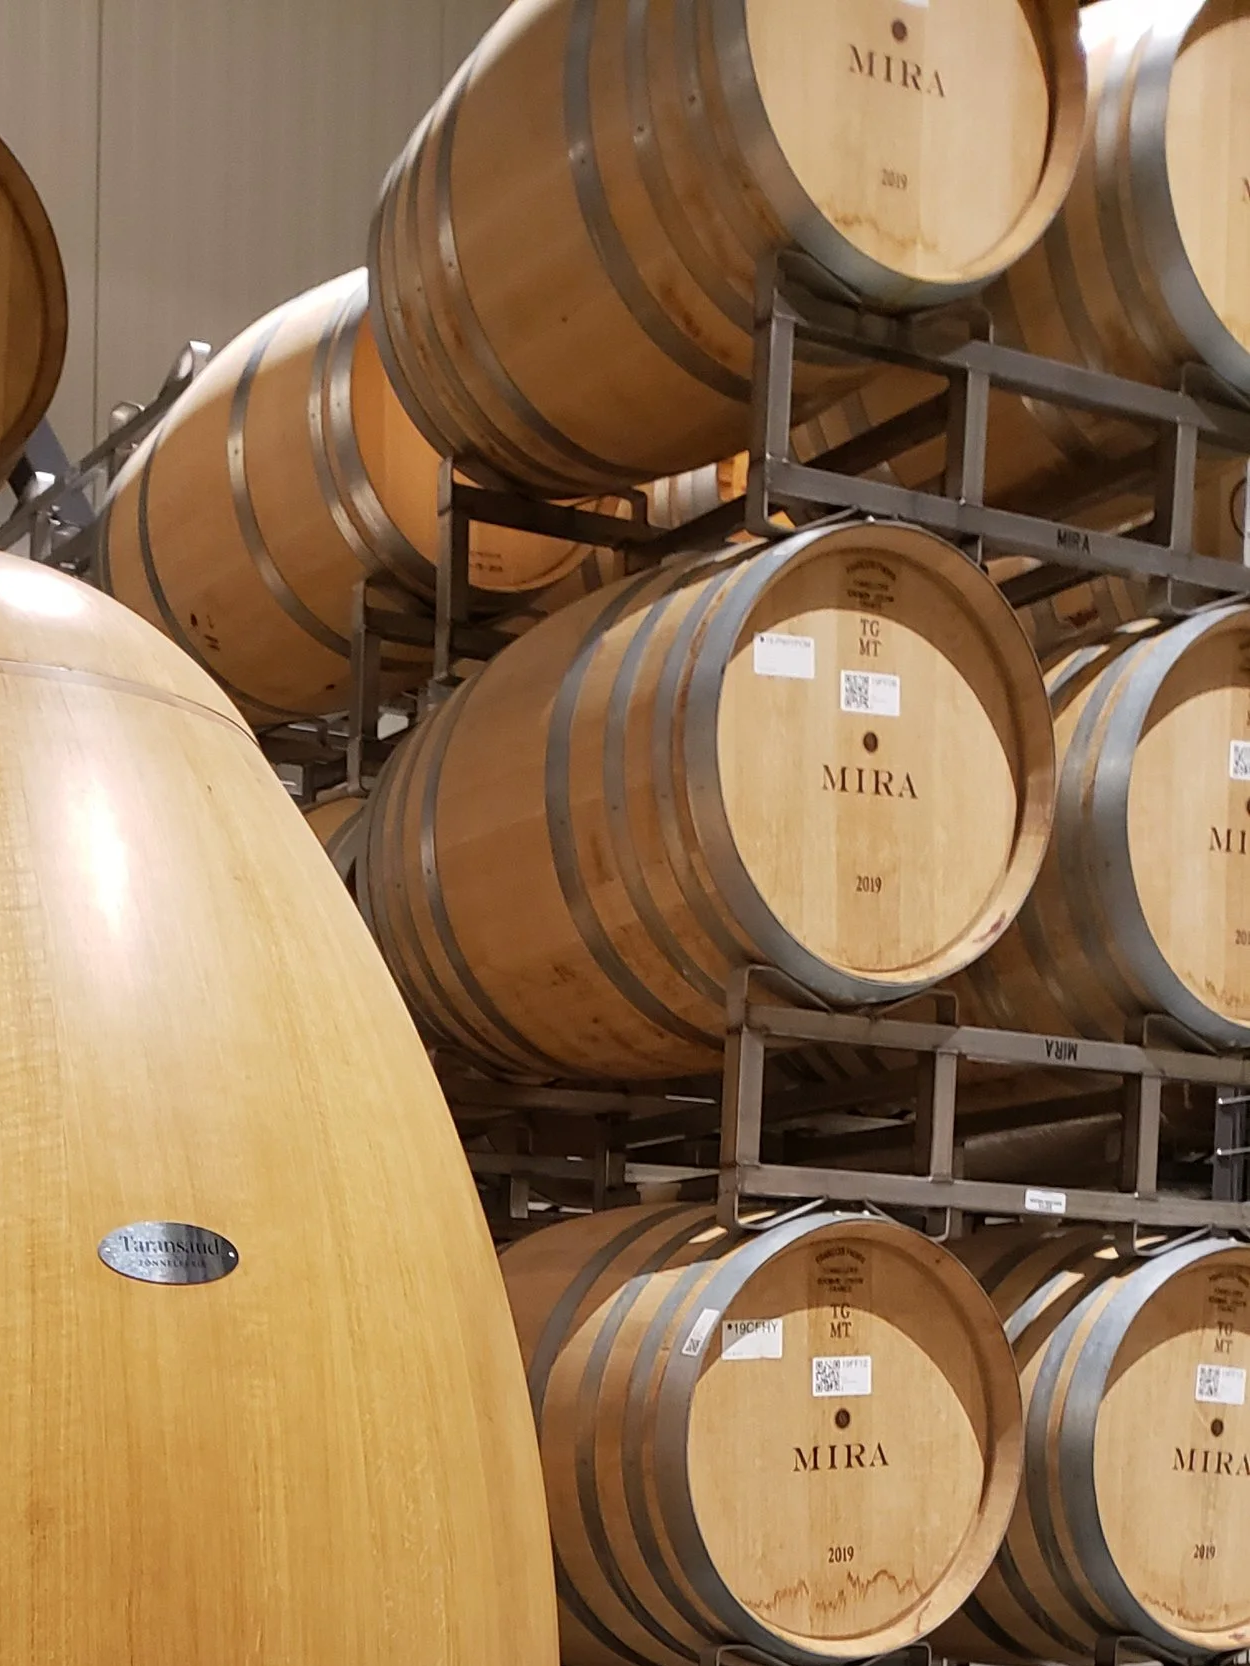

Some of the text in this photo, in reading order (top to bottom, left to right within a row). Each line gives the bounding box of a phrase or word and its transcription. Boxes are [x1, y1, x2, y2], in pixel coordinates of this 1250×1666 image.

[849, 43, 946, 98] MIRA
[881, 168, 908, 190] 2019
[1056, 527, 1092, 555] MIRA
[860, 617, 881, 637] TG
[859, 637, 882, 657] MT
[821, 763, 919, 800] MIRA
[1209, 826, 1247, 856] MI
[855, 875, 882, 894] 2019
[1045, 1038, 1078, 1062] MIRA
[118, 1234, 220, 1256] Taransaud
[830, 1302, 851, 1320] TG
[829, 1321, 852, 1339] MT
[1214, 1338, 1233, 1354] MT
[792, 1441, 889, 1473] MIRA
[1172, 1446, 1250, 1476] MIRA
[828, 1545, 855, 1564] 2019
[1193, 1543, 1217, 1561] 2019
